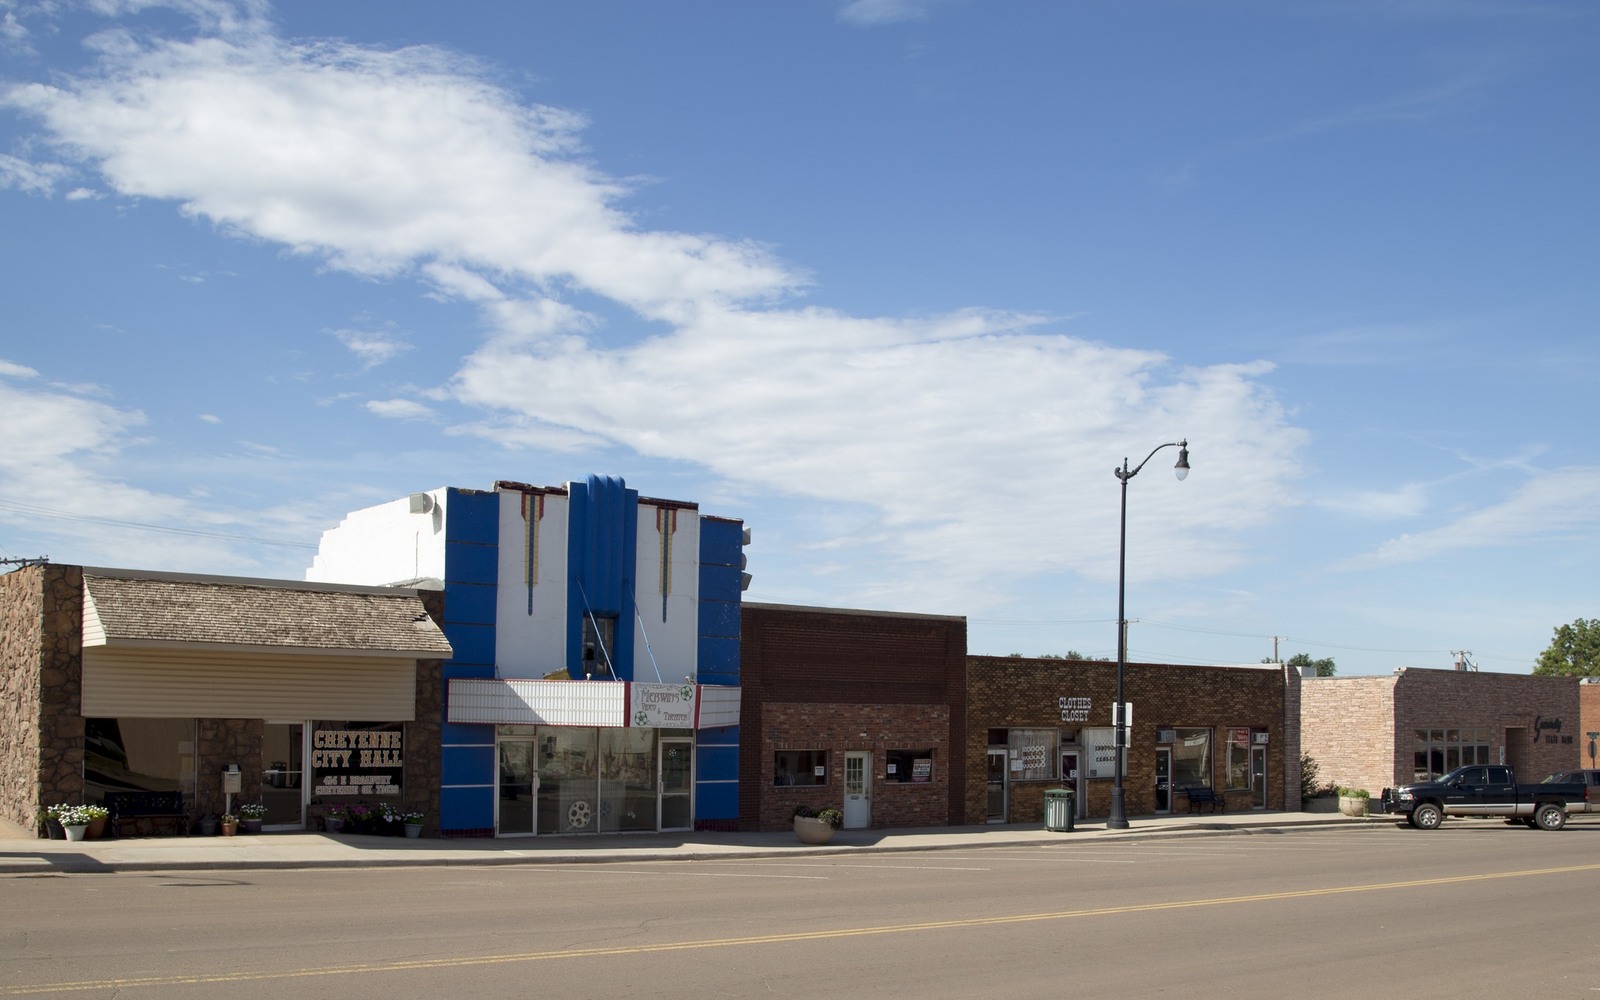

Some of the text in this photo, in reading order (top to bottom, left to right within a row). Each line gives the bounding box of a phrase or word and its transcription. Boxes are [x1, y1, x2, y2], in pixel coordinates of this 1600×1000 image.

[1059, 698, 1091, 709] CLOTHES
[1062, 710, 1088, 721] CLOSET
[314, 730, 401, 748] CHEYENNE
[312, 749, 402, 768] CITY HALL
[315, 785, 358, 795] CHEYENNE
